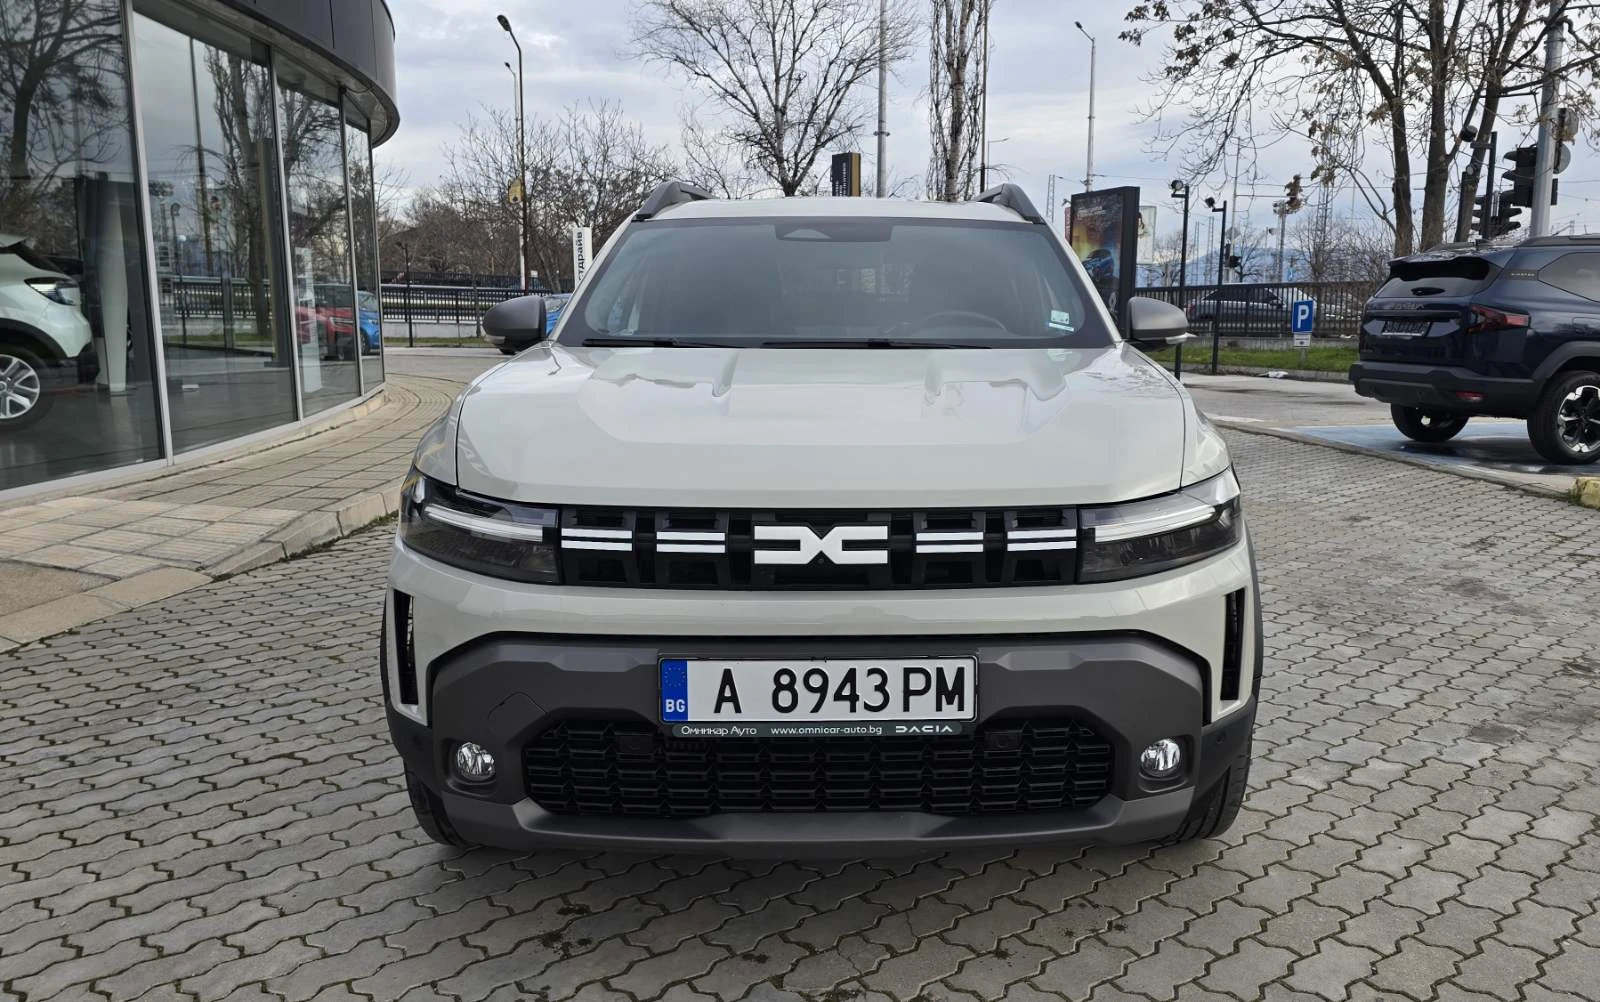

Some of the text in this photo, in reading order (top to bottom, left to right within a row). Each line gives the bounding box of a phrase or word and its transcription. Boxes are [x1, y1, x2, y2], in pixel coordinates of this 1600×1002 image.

[1297, 304, 1310, 329] P
[713, 666, 966, 715] A 8943 PM
[665, 699, 686, 713] BG
[680, 724, 757, 737] Омникар Ауто
[770, 724, 883, 736] www.omnicar-auto.bg
[895, 725, 953, 734] DACIA
